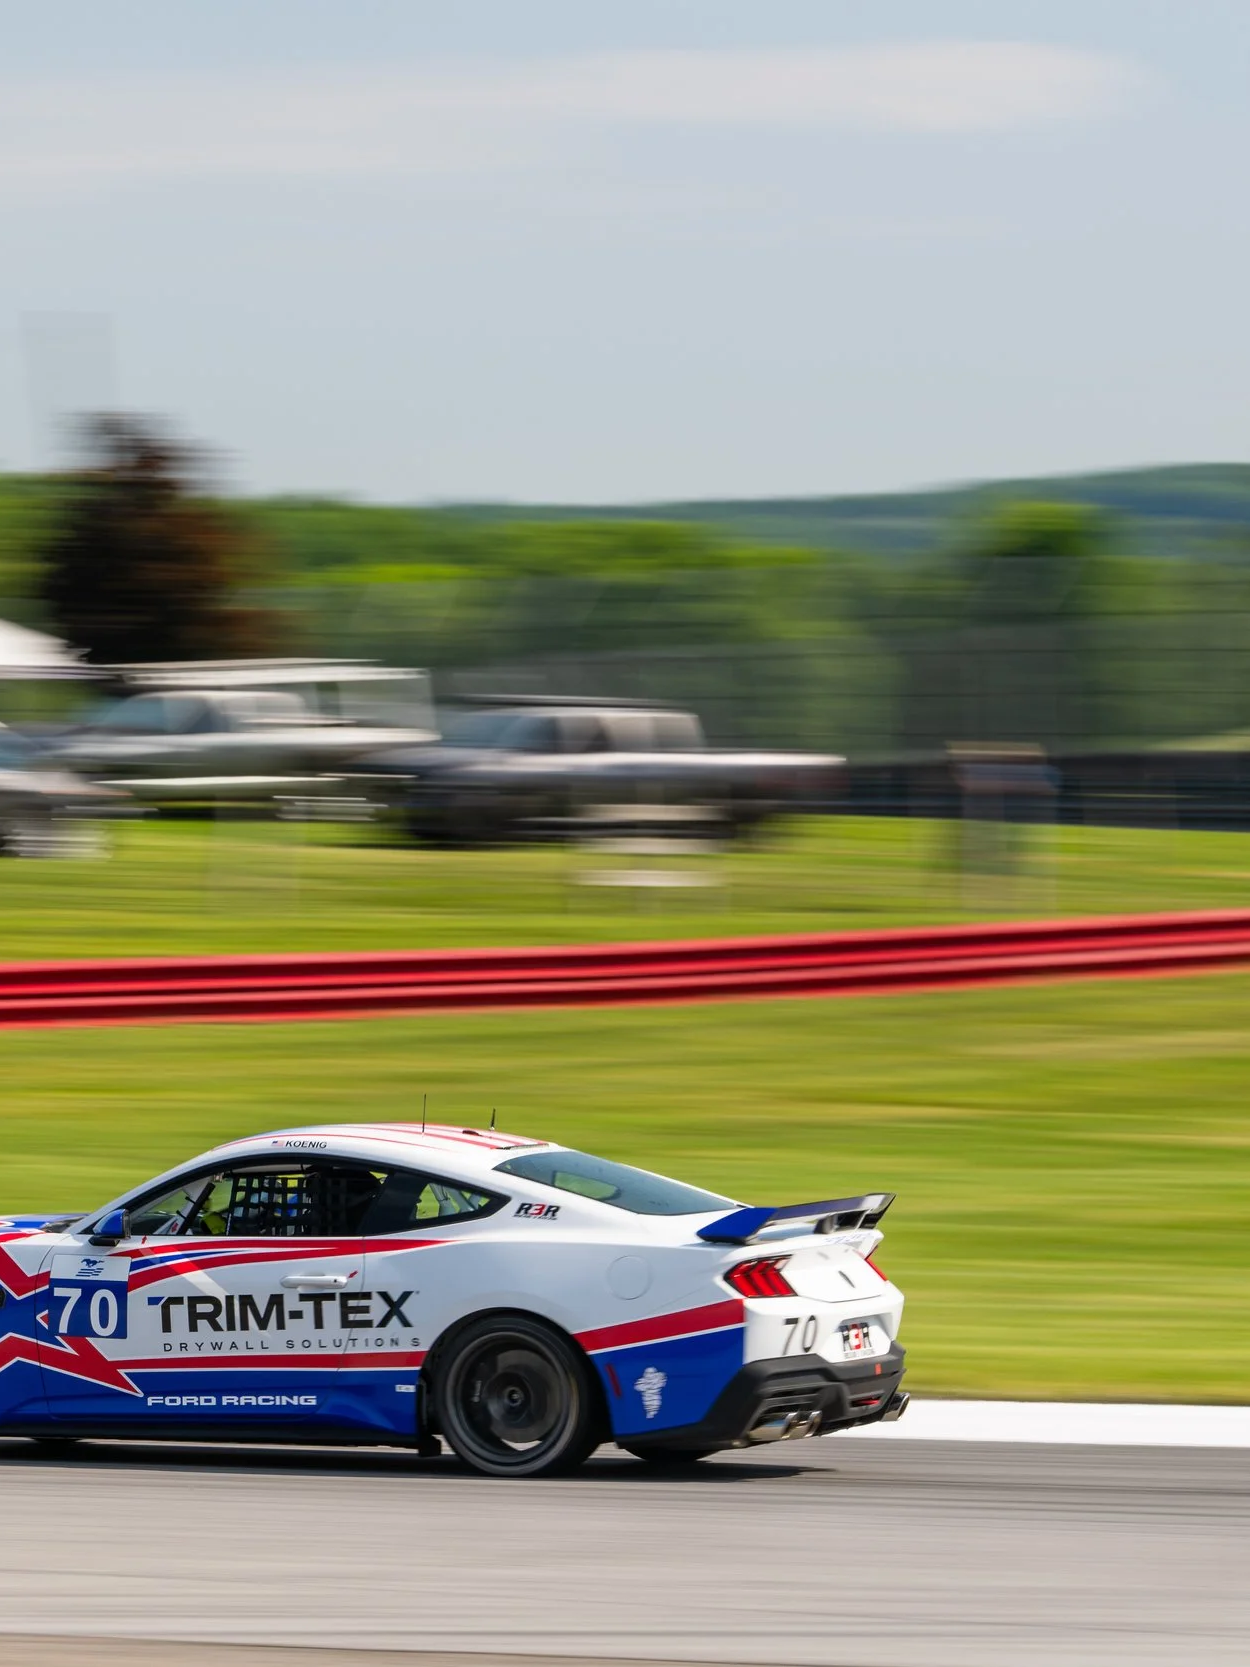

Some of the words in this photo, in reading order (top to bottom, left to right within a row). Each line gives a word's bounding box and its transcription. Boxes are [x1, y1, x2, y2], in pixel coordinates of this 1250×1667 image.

[285, 1140, 328, 1149] KOENIG
[515, 1202, 561, 1217] R3R
[53, 1287, 118, 1337] 70
[147, 1291, 415, 1333] TRIM-TEX
[782, 1315, 818, 1356] 70
[163, 1340, 270, 1352] DRYWALL
[286, 1337, 421, 1349] SOLUTIONS
[147, 1395, 217, 1406] FORD
[222, 1395, 317, 1406] RACING
